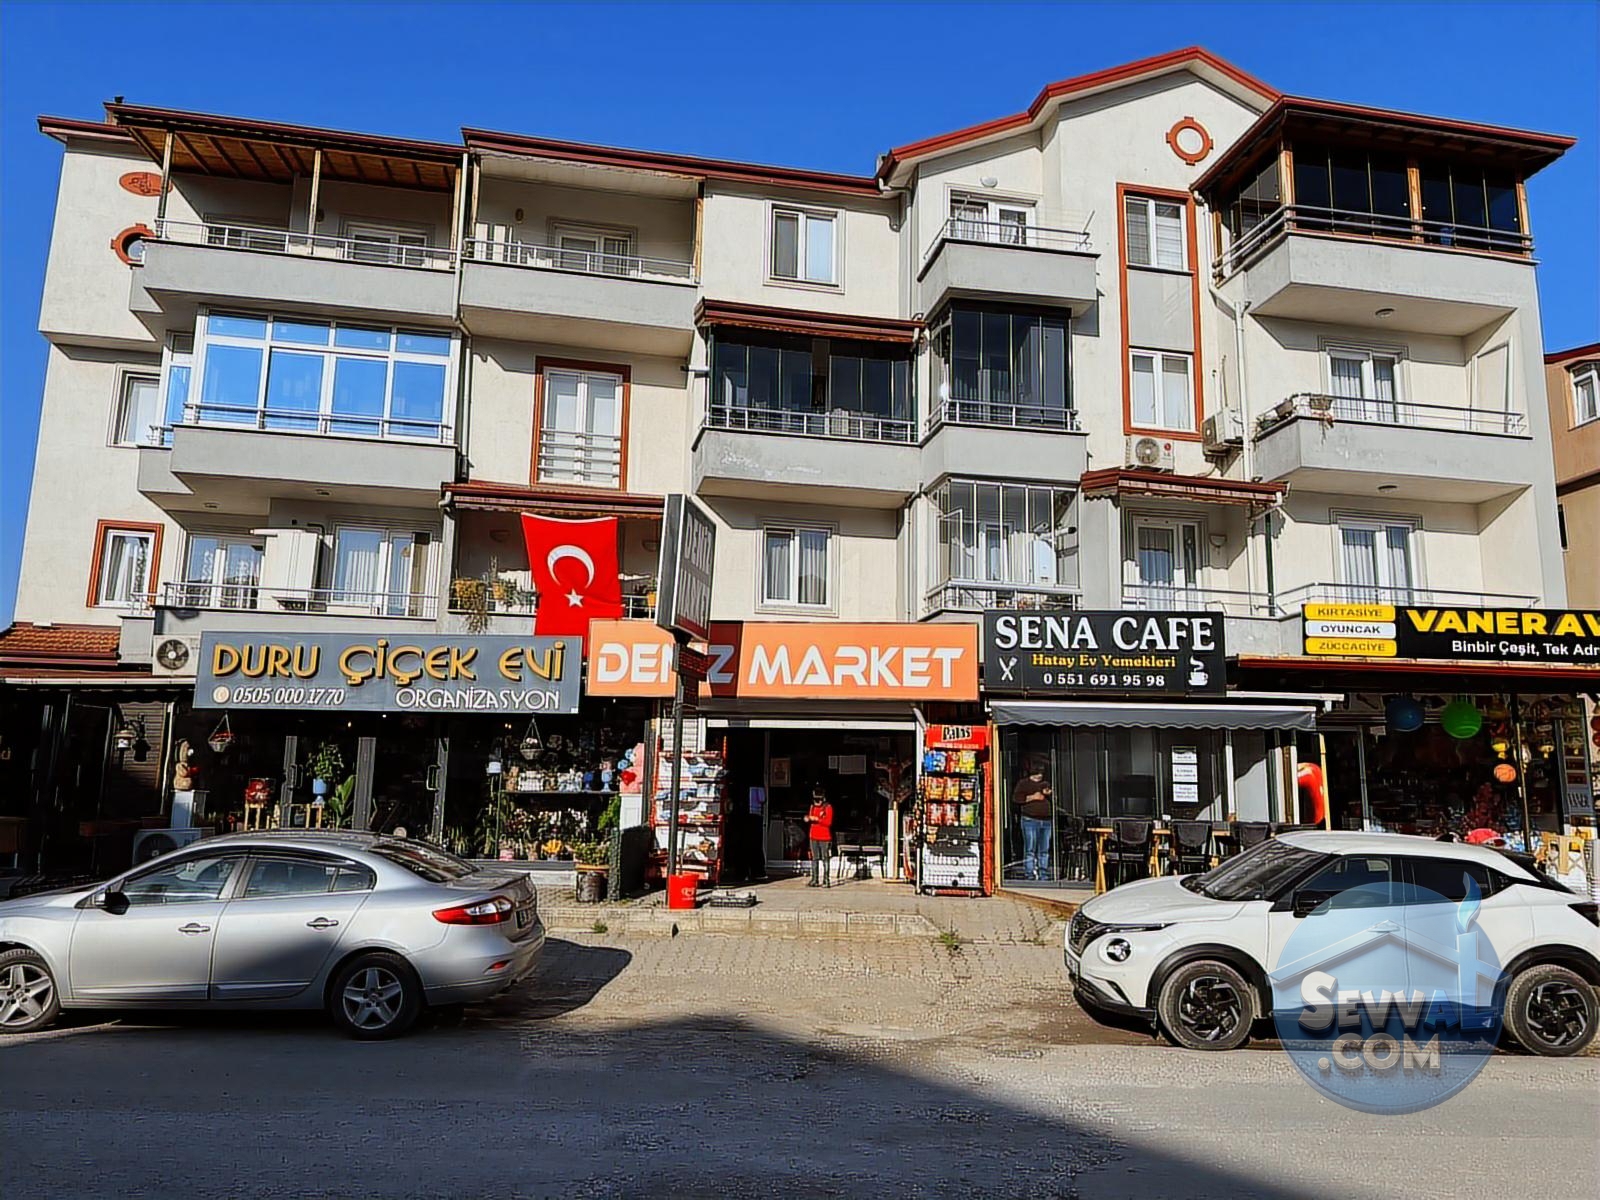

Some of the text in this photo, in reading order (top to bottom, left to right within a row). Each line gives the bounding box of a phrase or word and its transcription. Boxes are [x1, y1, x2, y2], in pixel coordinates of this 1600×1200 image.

[1317, 607, 1383, 617] KIRTASİYE
[1320, 624, 1381, 634] OYUNCAK
[1406, 609, 1547, 635] VANER
[995, 616, 1216, 651] SENA CAFE
[1452, 640, 1496, 653] Binbir
[1499, 640, 1540, 657] Çeşit,
[1543, 642, 1569, 656] Tek
[212, 638, 566, 687] DURU ÇİÇEK EVİ
[747, 643, 965, 688] MARKET
[1031, 653, 1177, 669] Hatay Ev Yemekleri
[1043, 672, 1166, 687] 0 551 691 95 98
[232, 686, 273, 704] 0505
[275, 687, 305, 704] 000
[395, 685, 560, 710] ORGANİZASYON
